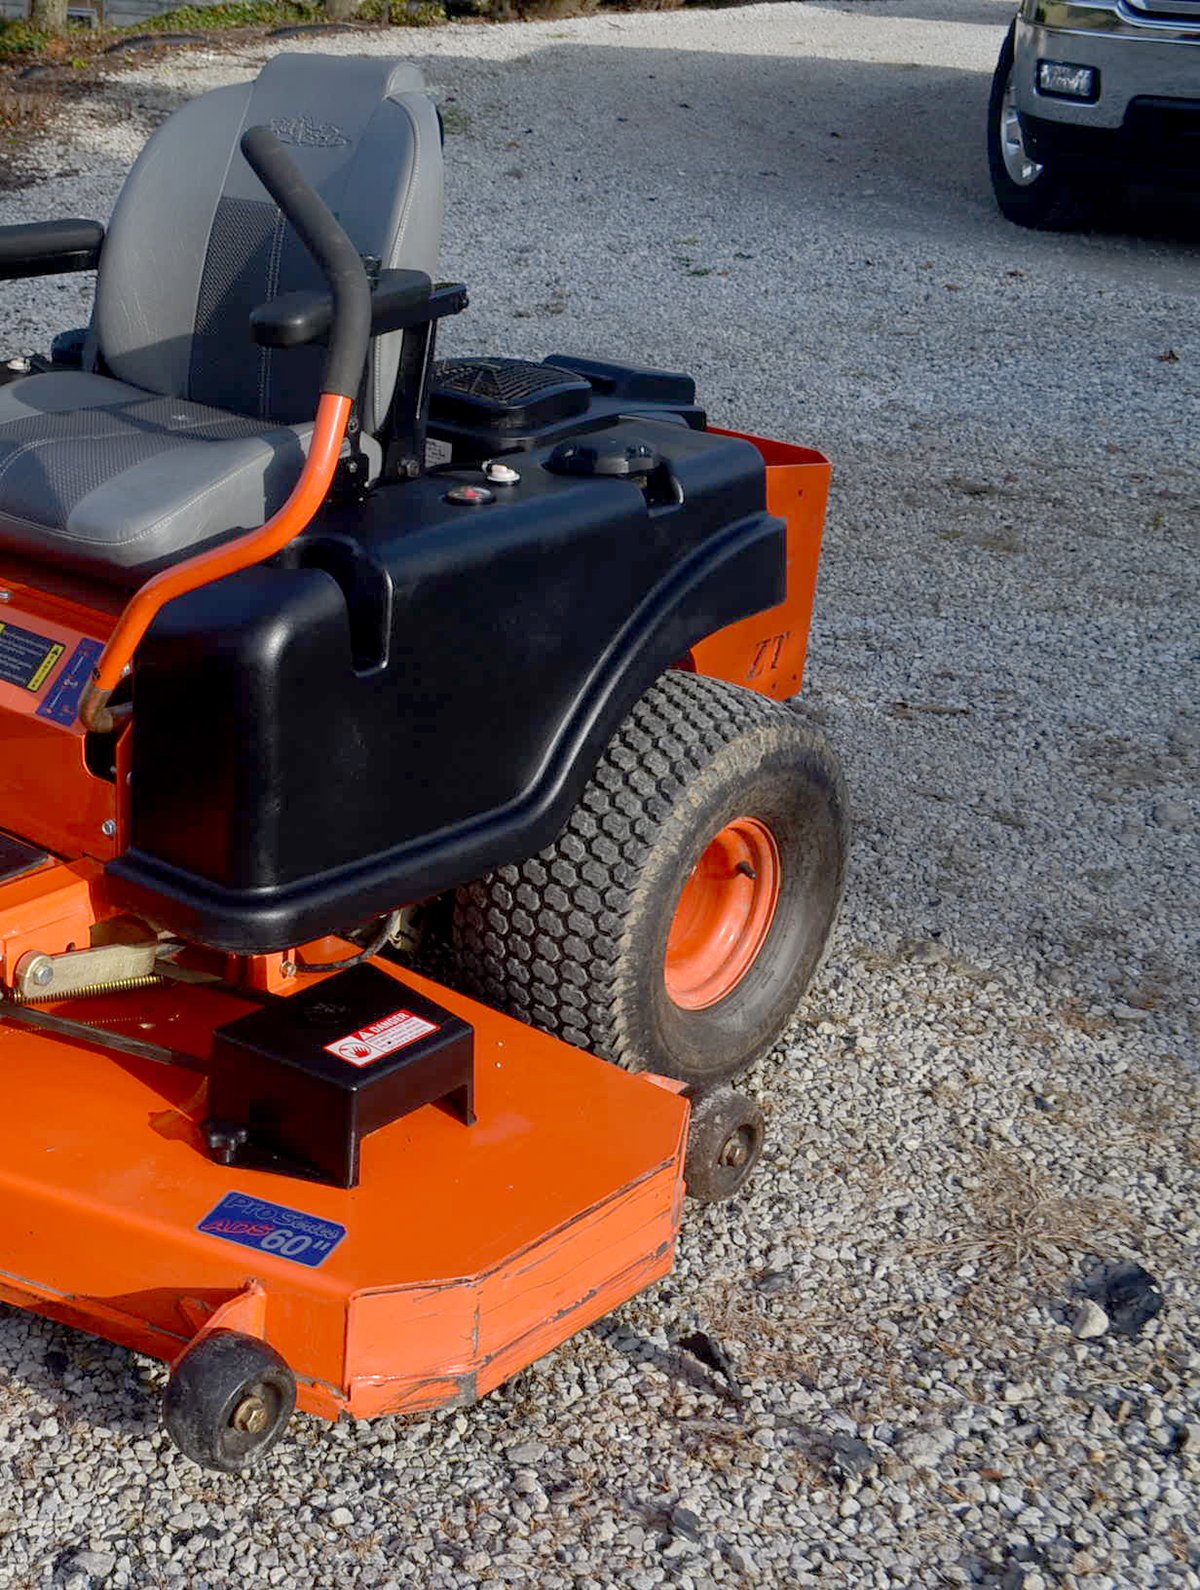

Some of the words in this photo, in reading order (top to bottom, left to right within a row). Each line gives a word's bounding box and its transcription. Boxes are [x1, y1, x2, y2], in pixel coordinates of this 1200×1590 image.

[370, 1012, 411, 1033] DANGER
[200, 1218, 275, 1237] ADS
[261, 1229, 331, 1256] 60"
